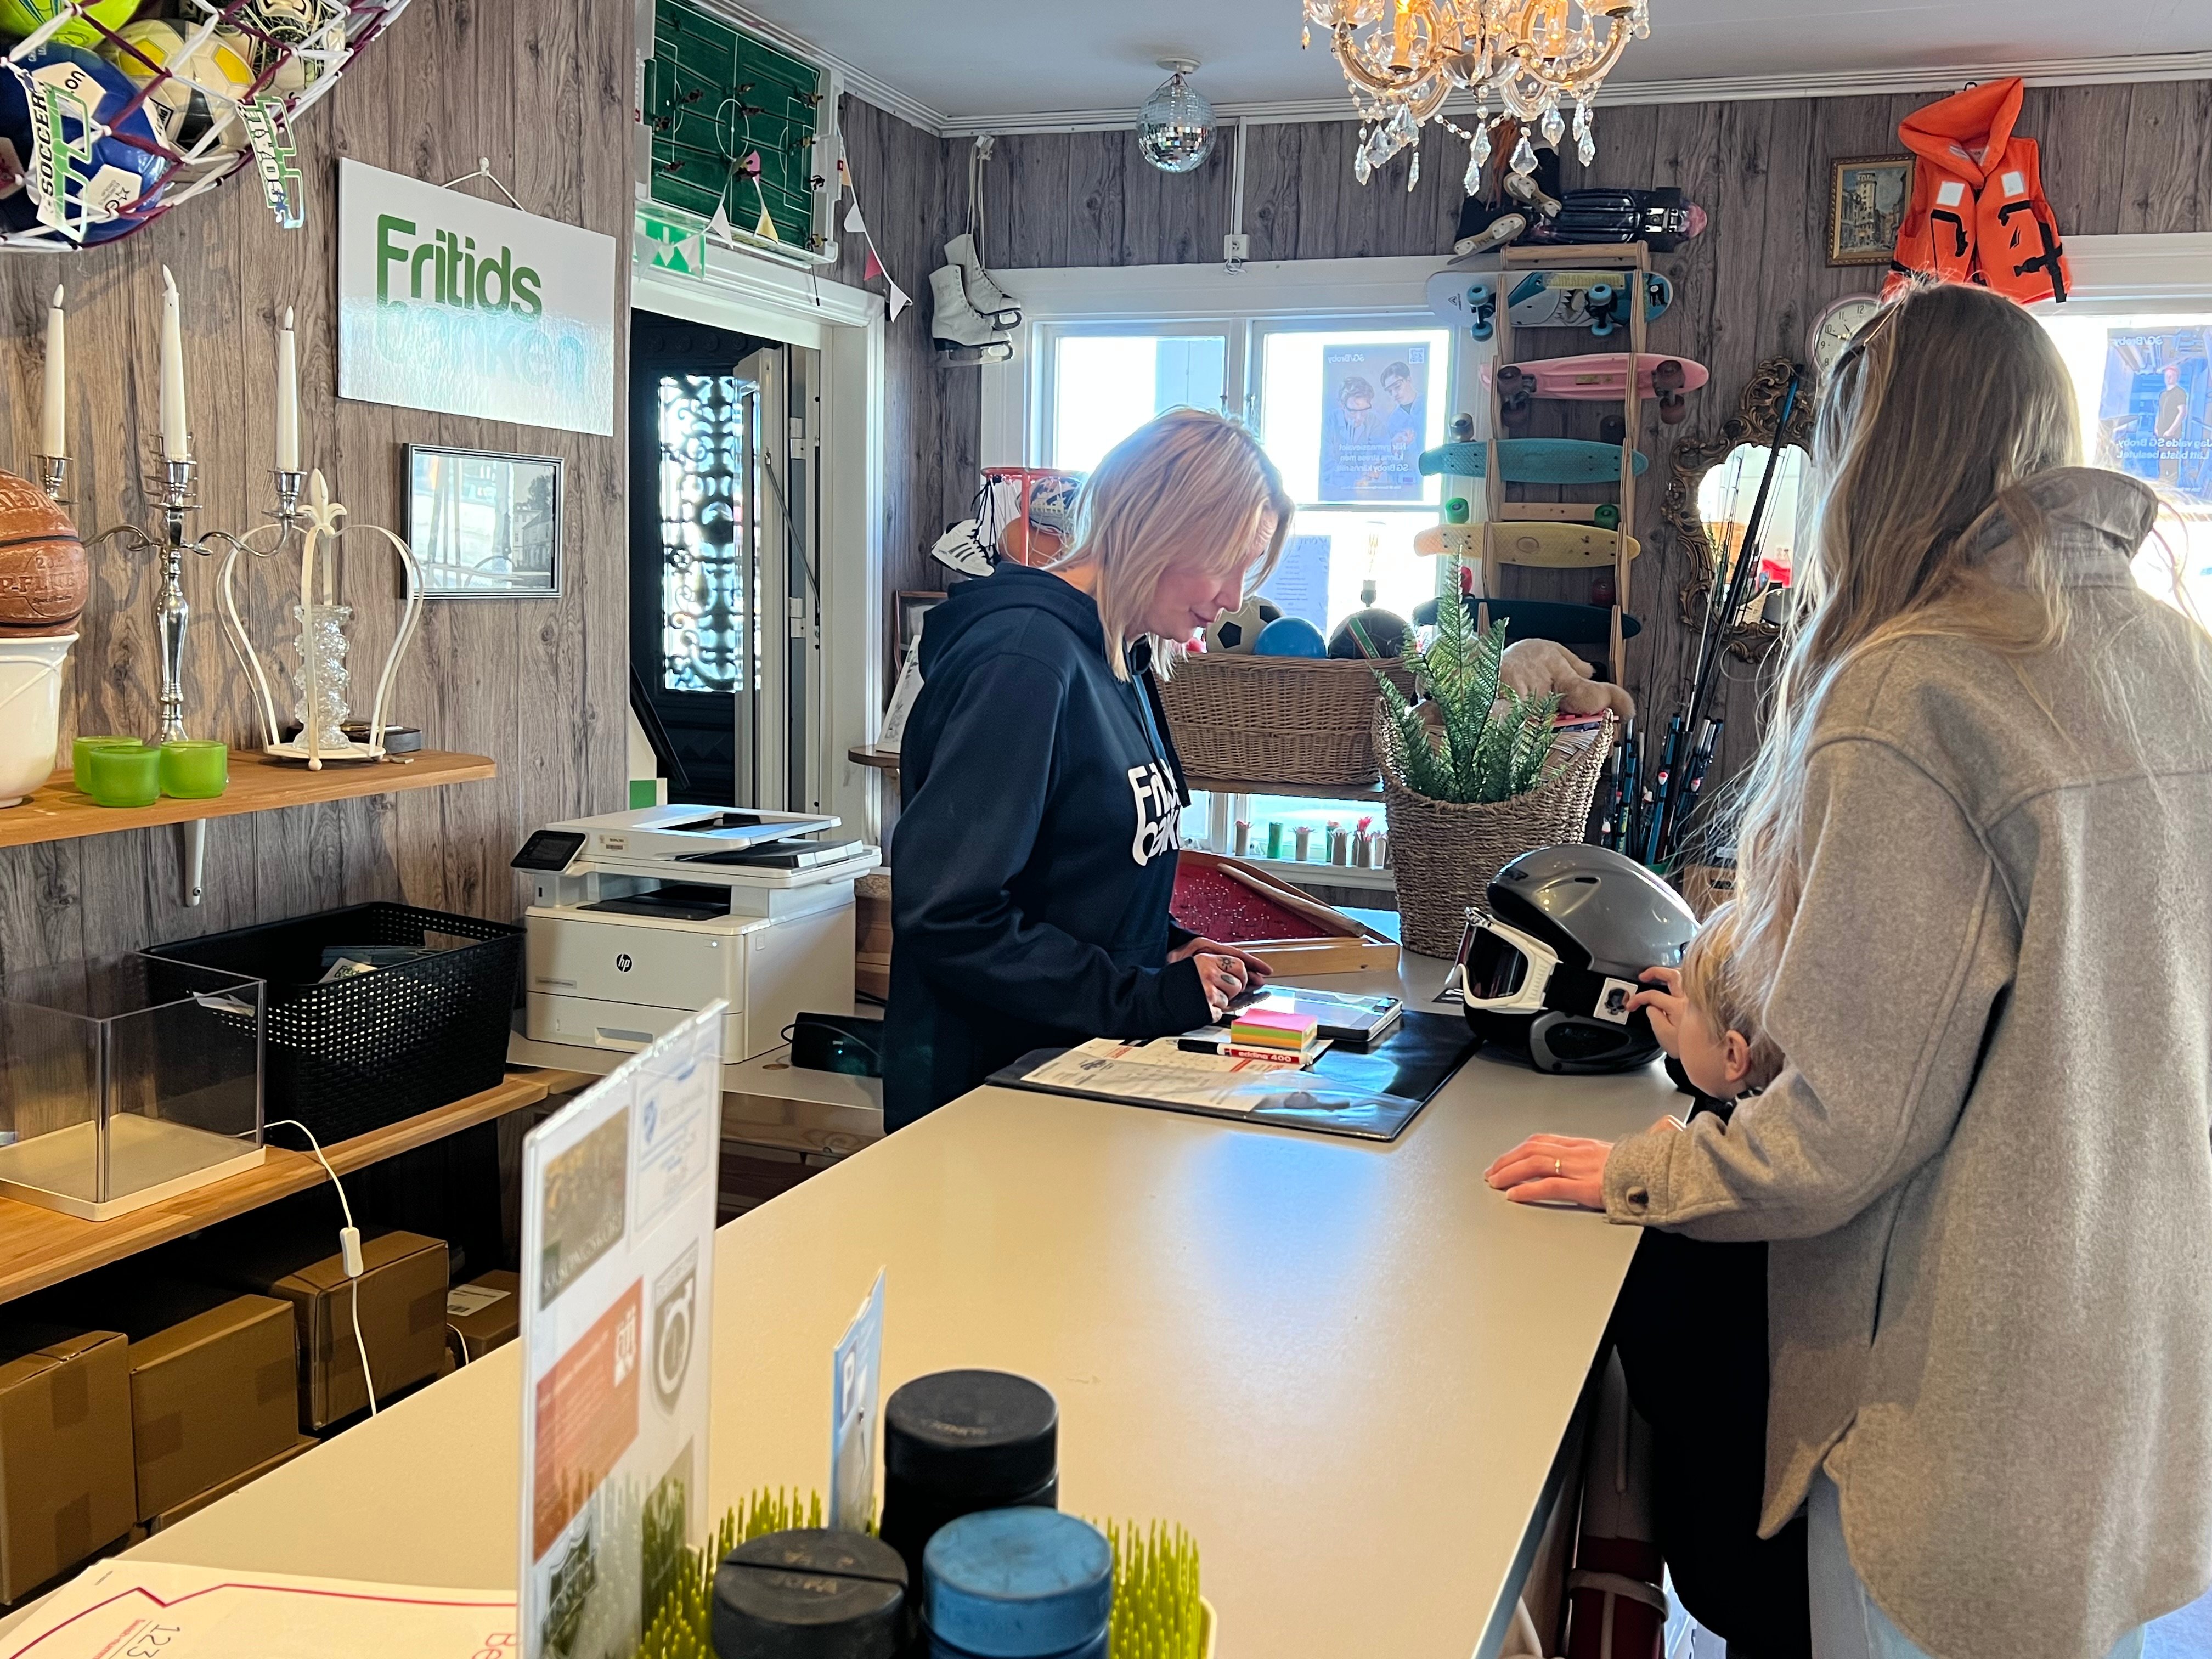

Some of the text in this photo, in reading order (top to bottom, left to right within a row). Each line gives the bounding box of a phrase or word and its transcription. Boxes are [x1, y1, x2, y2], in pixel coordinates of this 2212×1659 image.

[31, 91, 54, 197] SOCCER
[377, 213, 543, 324] Fritids
[1857, 305, 1865, 314] 12
[1838, 311, 1844, 320] 11
[1825, 324, 1832, 333] 10
[1824, 358, 1830, 366] 8
[617, 953, 632, 973] hp
[1238, 1051, 1268, 1060] edding
